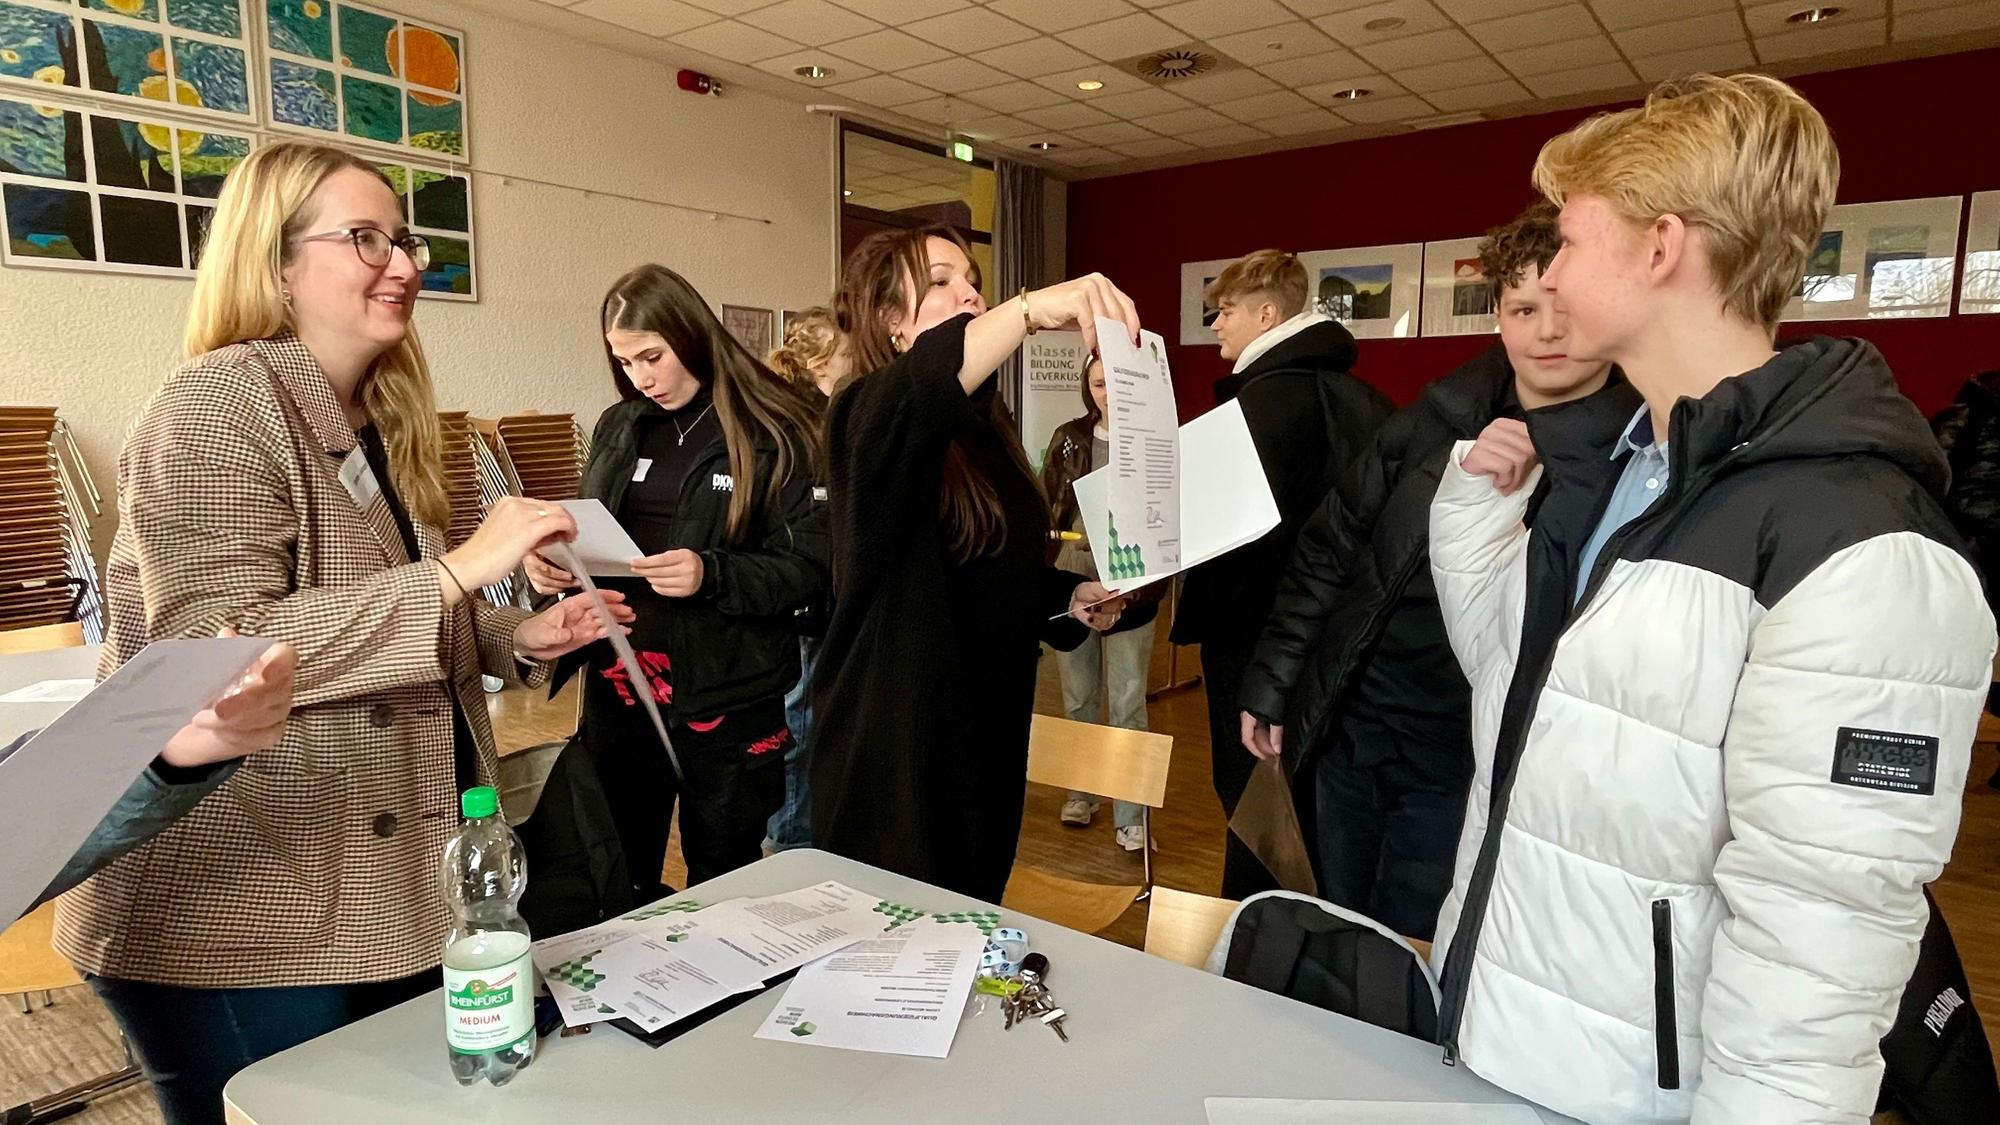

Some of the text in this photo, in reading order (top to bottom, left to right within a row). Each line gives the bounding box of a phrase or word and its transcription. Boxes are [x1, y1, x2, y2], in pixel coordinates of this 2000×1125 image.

[1030, 359, 1075, 370] BILDUNG
[1030, 371, 1081, 382] LEVERKUS
[712, 473, 734, 488] DKN
[1852, 732, 1881, 740] PREMIUM
[1857, 762, 1911, 778] STATEWIDE
[1850, 776, 1888, 787] OUTERWEAR
[451, 991, 509, 1007] RHEINFÜRST
[1923, 987, 1965, 1038] PEGADOR
[459, 1014, 501, 1025] MEDIUM
